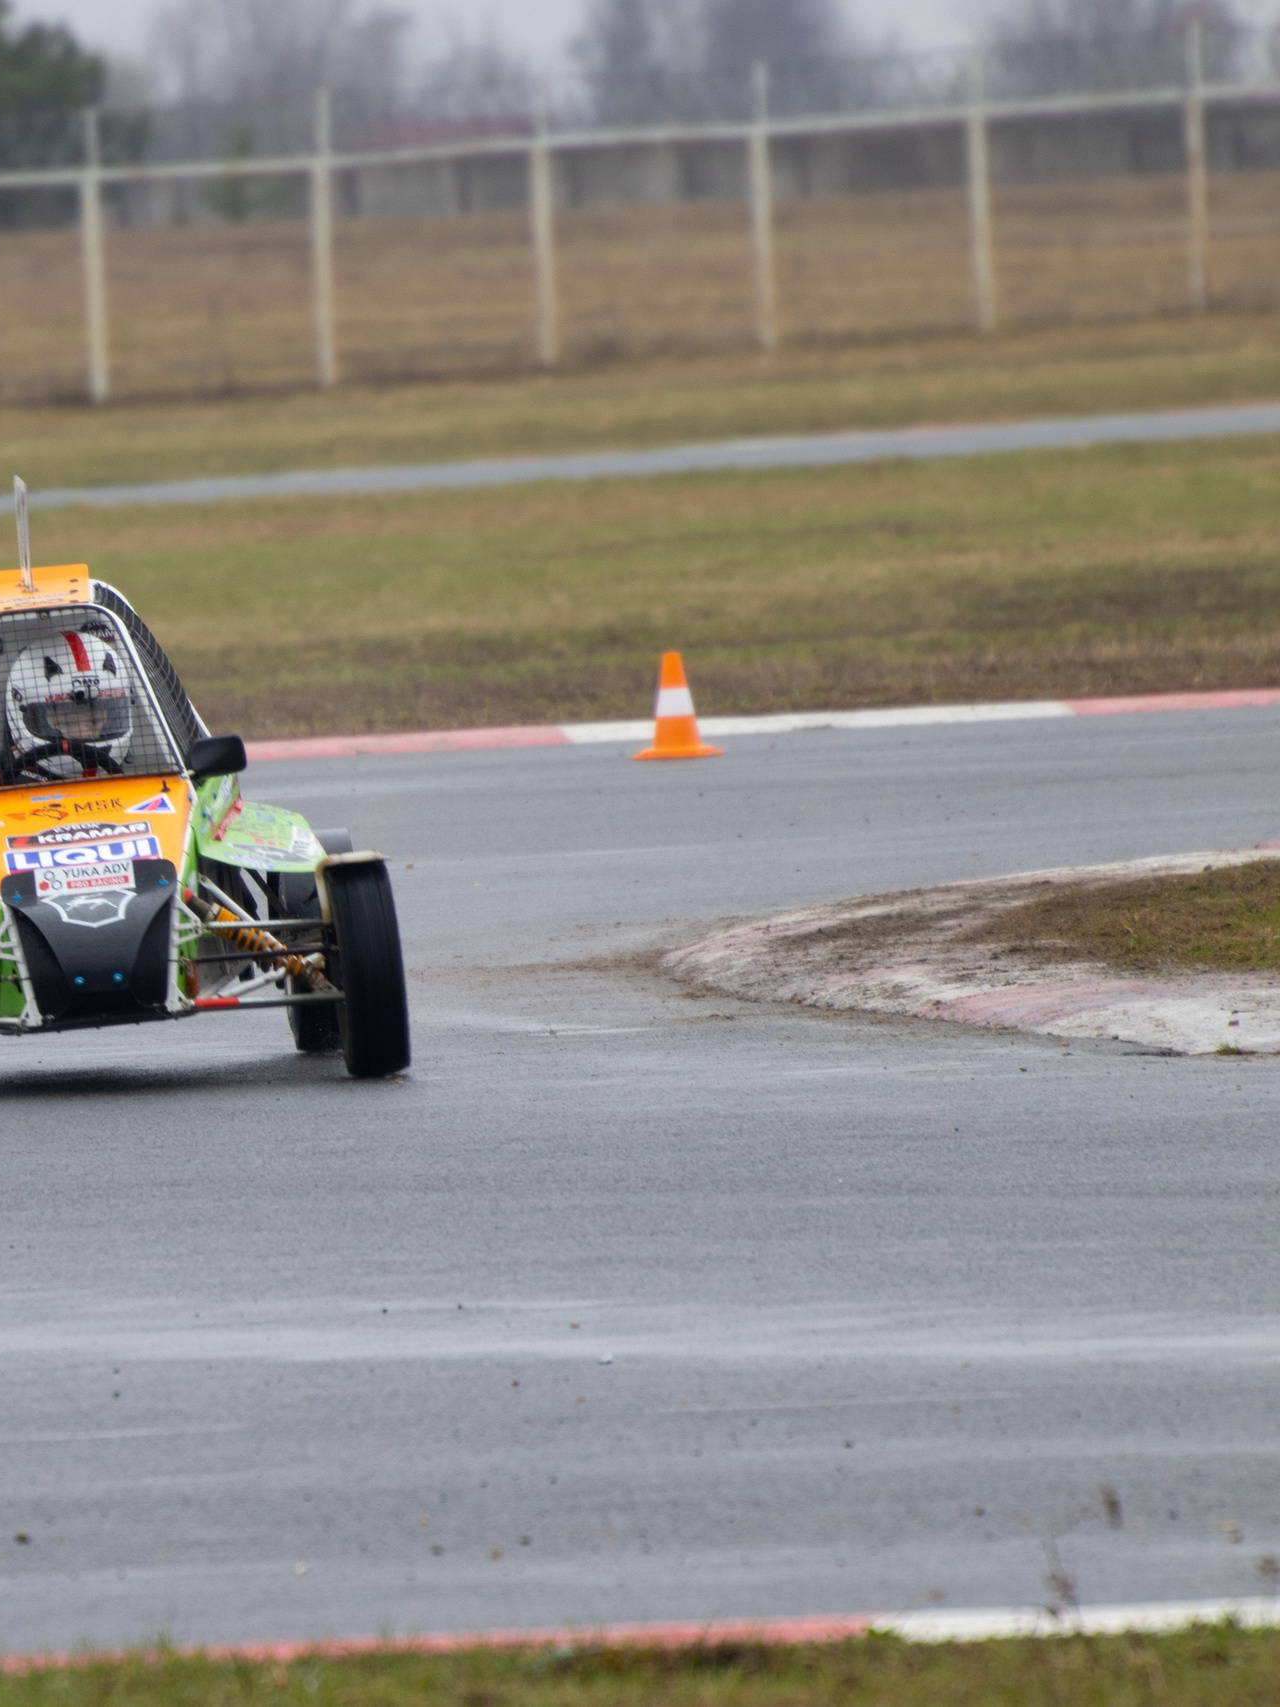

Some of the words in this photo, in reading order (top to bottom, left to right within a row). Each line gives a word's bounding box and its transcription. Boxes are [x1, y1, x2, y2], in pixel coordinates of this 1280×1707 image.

[74, 797, 123, 813] MSK
[37, 822, 147, 844] KRAMAR
[14, 839, 150, 870] LIQUI
[62, 866, 100, 878] YUKA
[103, 861, 130, 875] ADV
